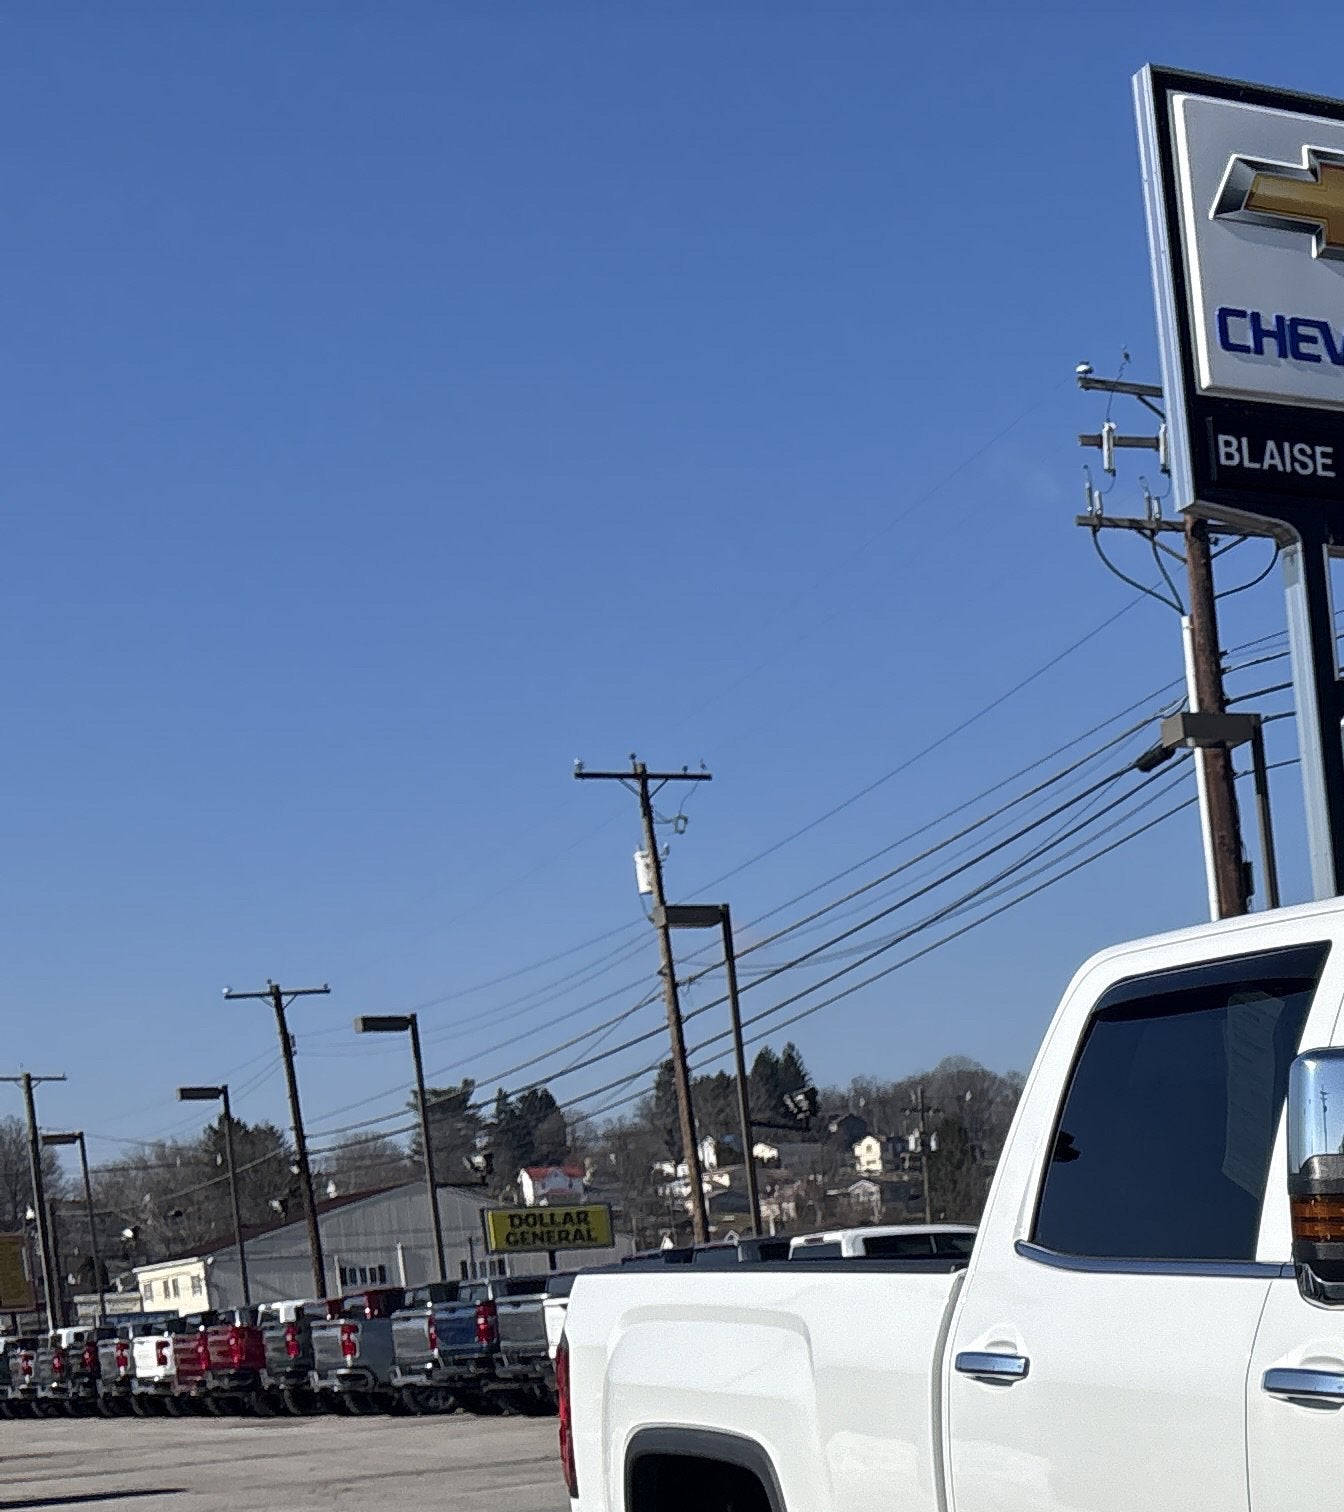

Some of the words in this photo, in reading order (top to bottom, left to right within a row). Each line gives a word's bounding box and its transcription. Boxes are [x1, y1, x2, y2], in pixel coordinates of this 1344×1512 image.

[1217, 433, 1337, 479] BLAISE
[507, 1209, 591, 1229] DOLLAR
[504, 1228, 599, 1246] GENERAL
